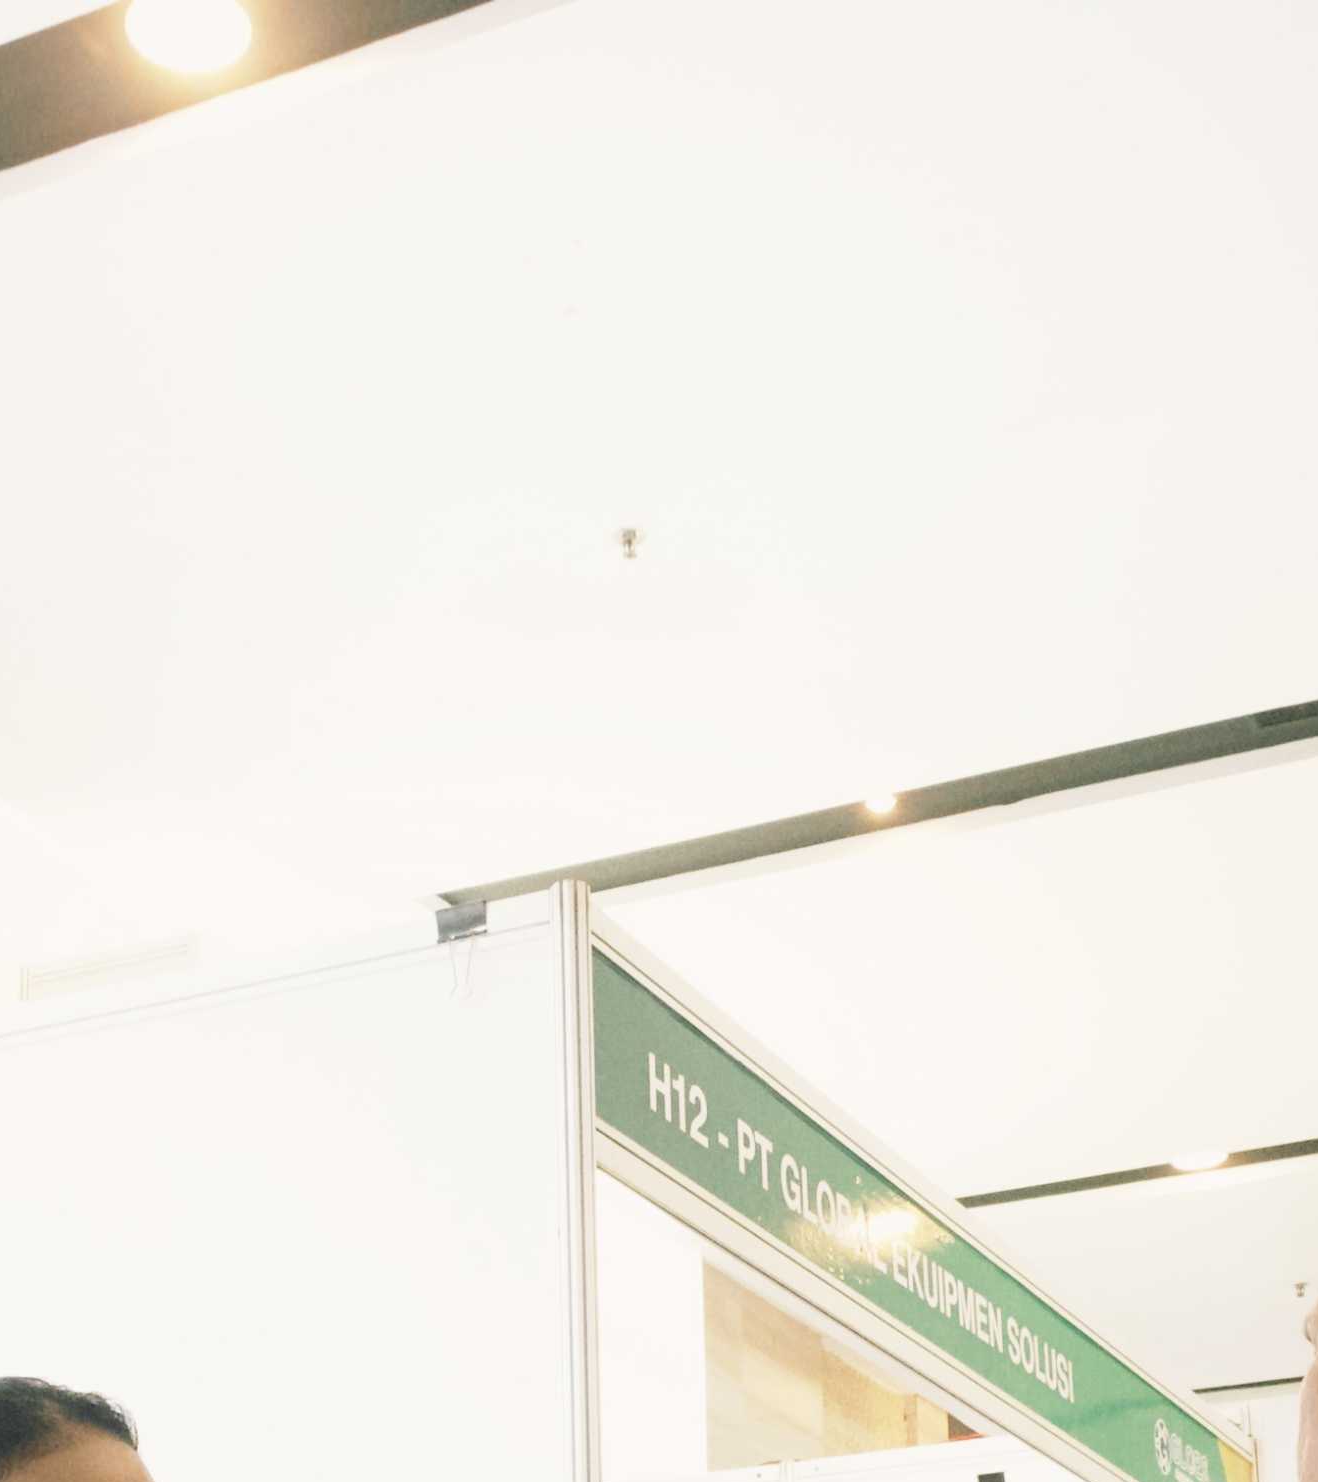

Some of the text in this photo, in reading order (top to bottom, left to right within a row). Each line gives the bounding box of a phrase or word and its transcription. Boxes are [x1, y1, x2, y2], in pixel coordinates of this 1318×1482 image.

[648, 1052, 710, 1149] H12
[737, 1117, 774, 1192] PT
[891, 1241, 1004, 1354] EKUIPMEN
[1007, 1315, 1074, 1403] SOLUSI
